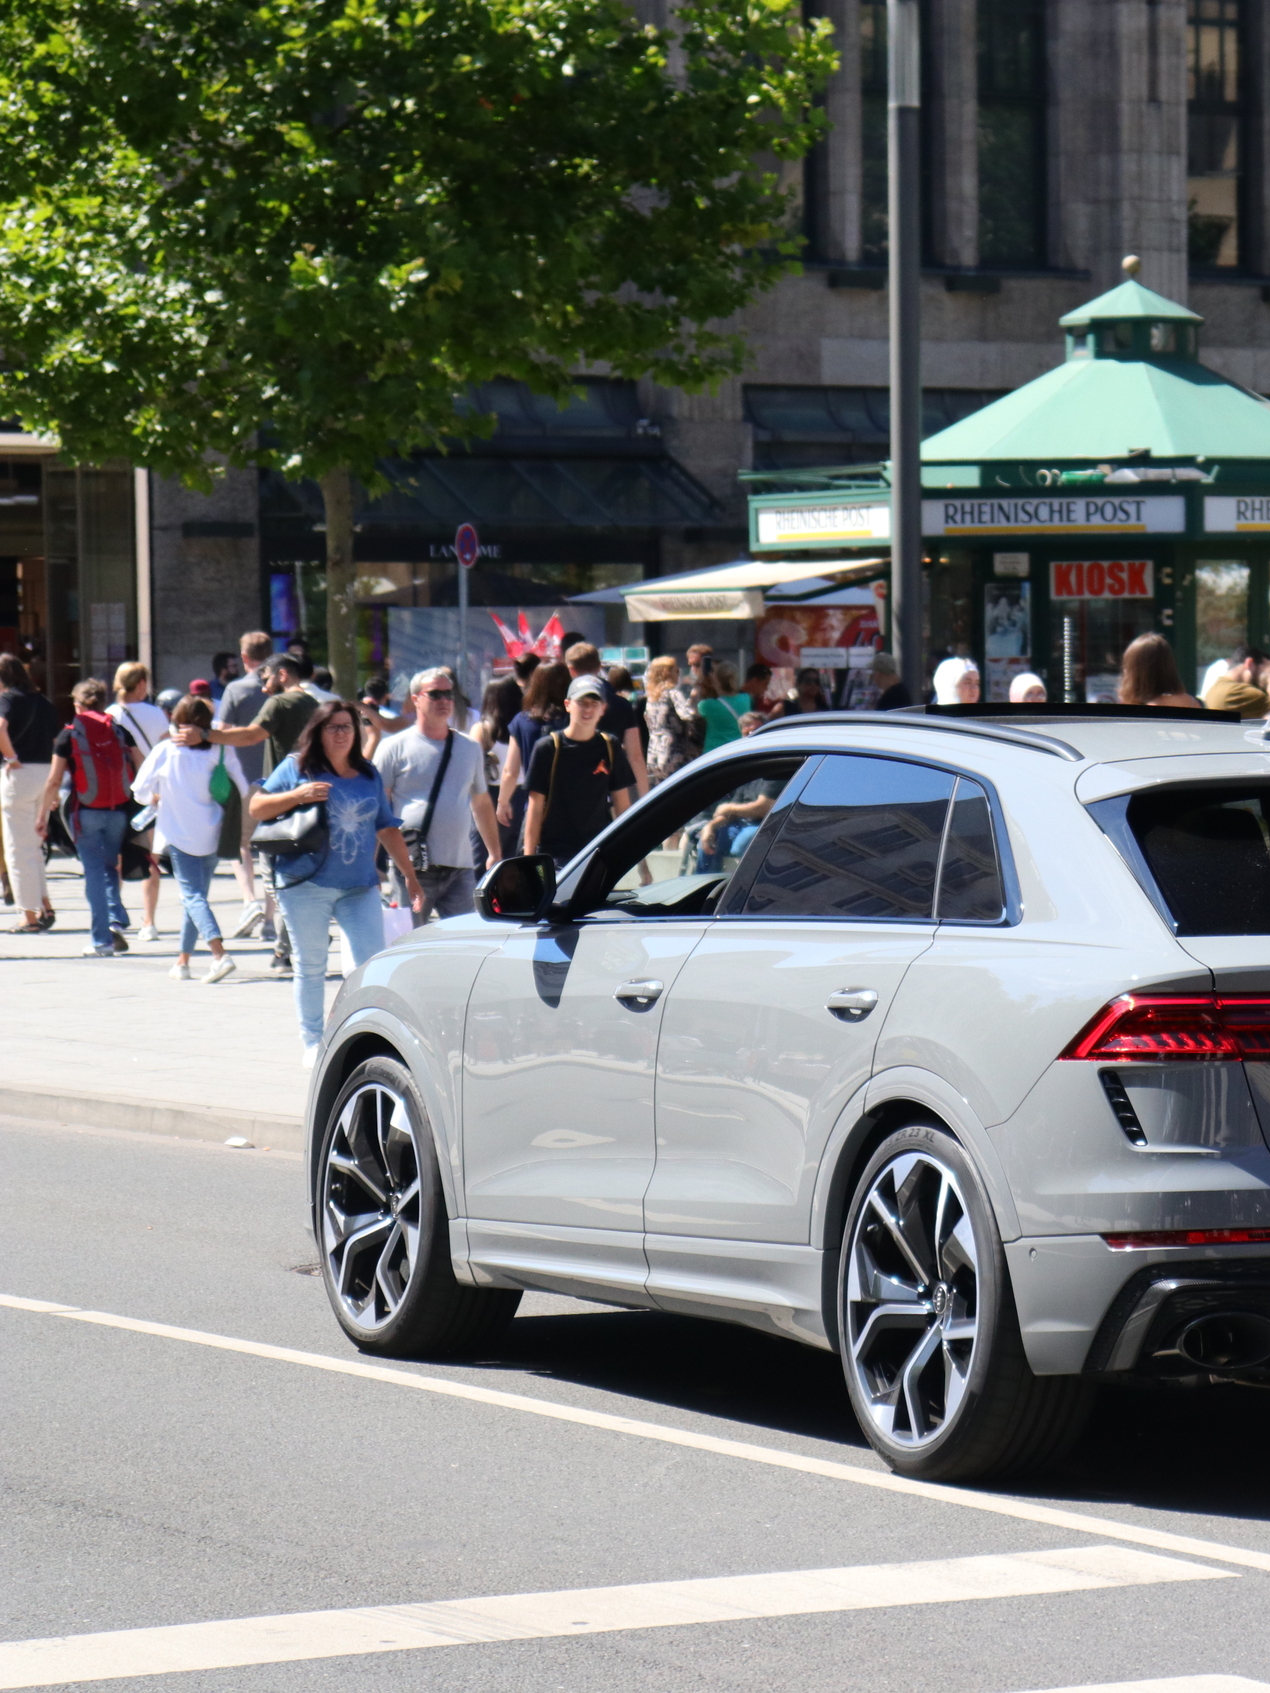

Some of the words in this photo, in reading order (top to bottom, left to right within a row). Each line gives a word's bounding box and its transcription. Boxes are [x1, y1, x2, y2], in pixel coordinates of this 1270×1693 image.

[775, 506, 839, 530] RHEINISCHE
[842, 504, 872, 527] POST
[943, 501, 1077, 525] RHEINISCHE
[1085, 500, 1146, 523] POST
[429, 544, 501, 558] LANME
[1053, 561, 1149, 597] KIOSK
